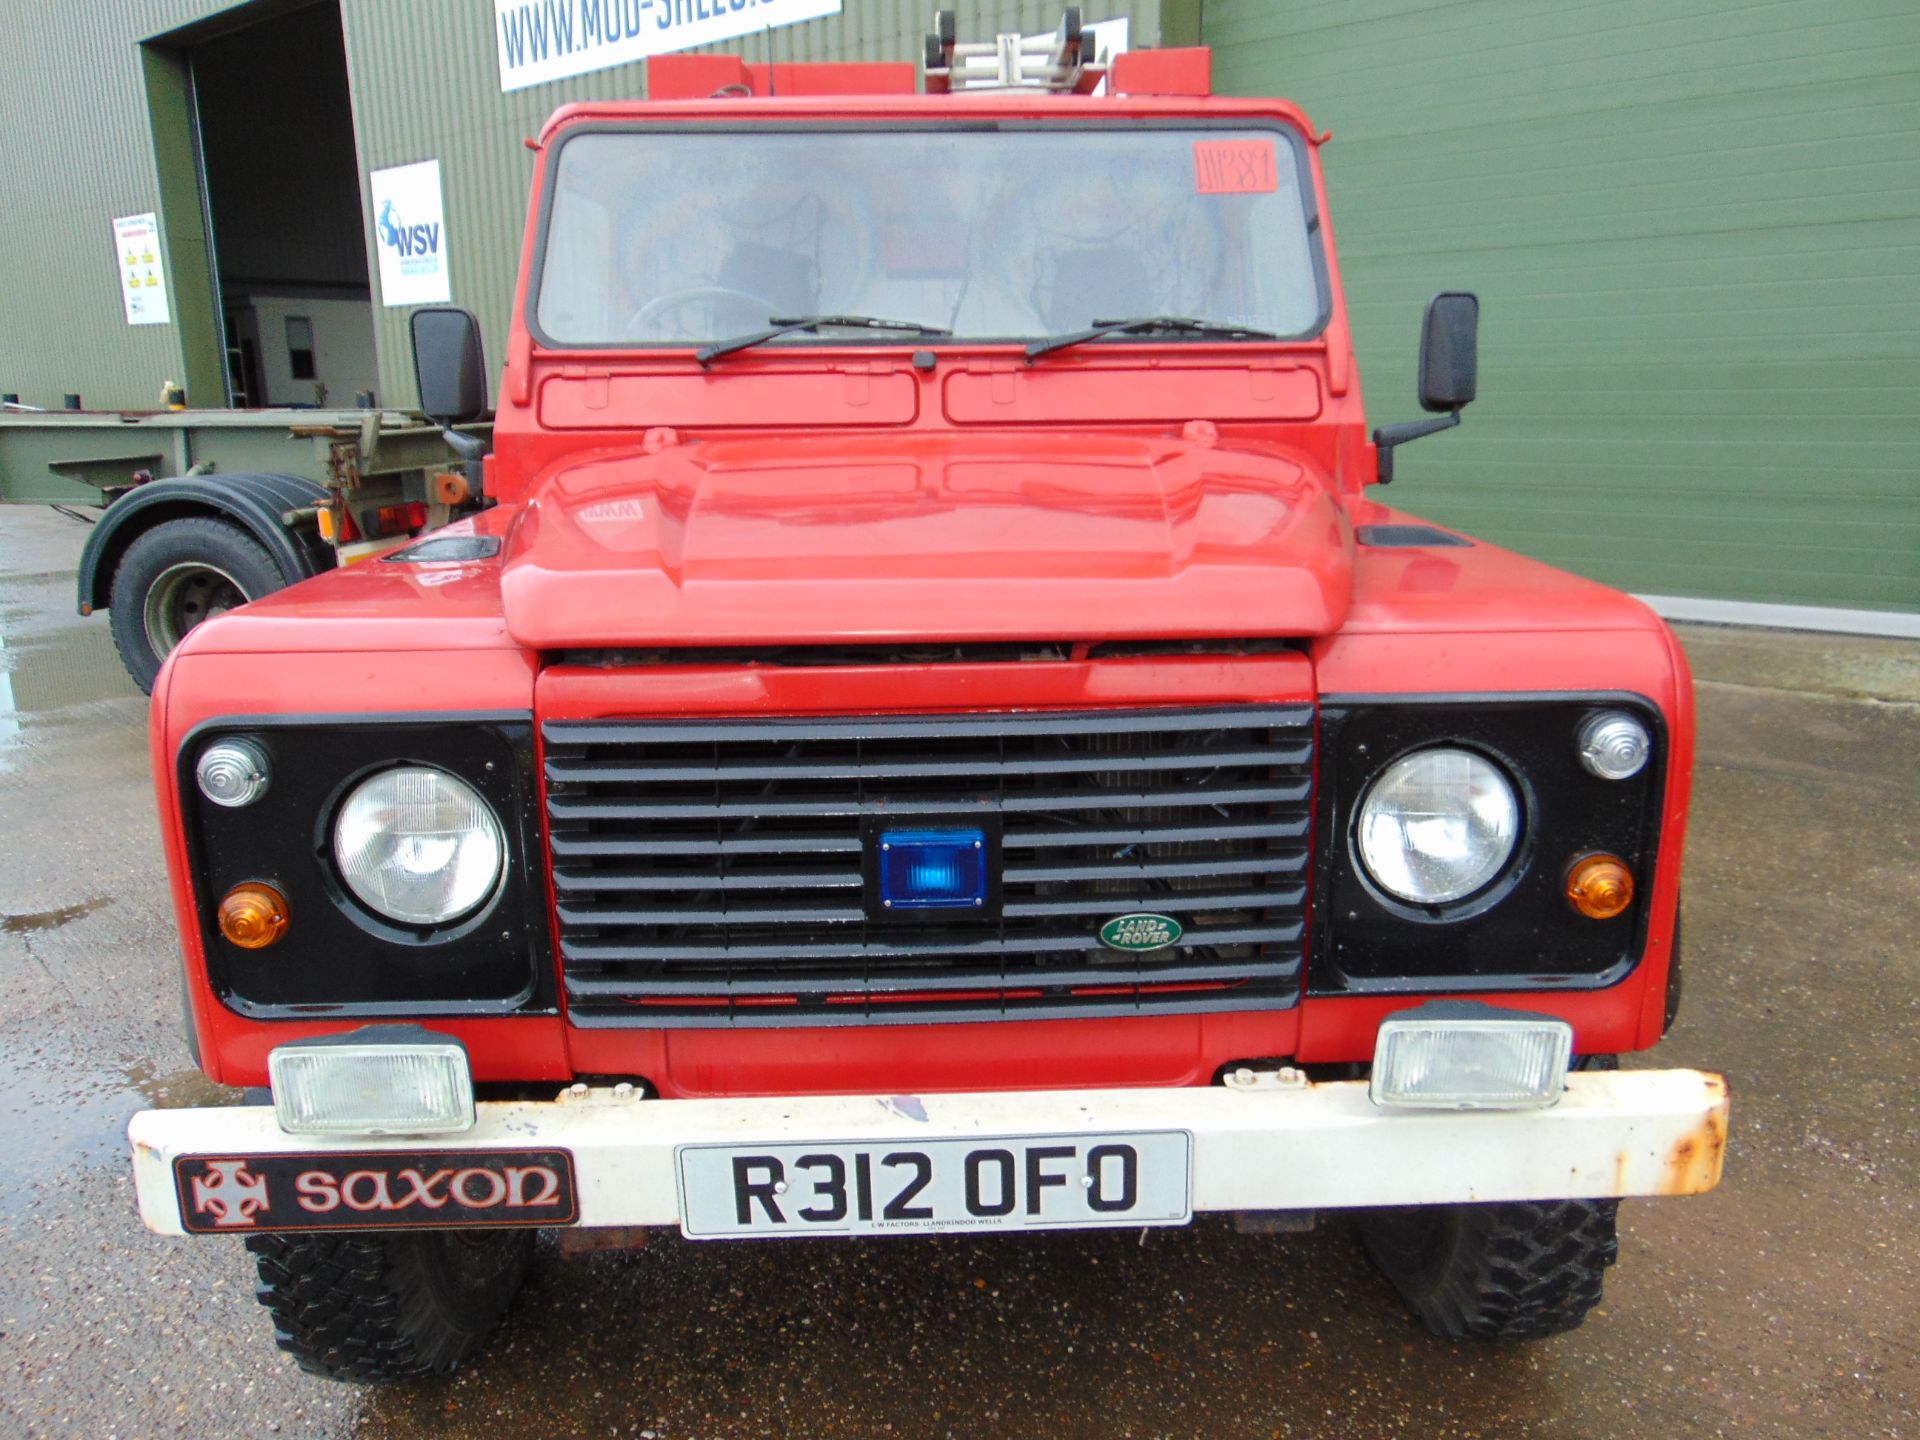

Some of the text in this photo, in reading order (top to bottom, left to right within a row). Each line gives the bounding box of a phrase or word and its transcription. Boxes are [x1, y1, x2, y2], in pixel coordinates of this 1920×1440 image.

[396, 222, 438, 257] WSV
[1117, 919, 1158, 933] LAND
[1120, 931, 1170, 945] ROVER
[731, 1152, 934, 1225] R312
